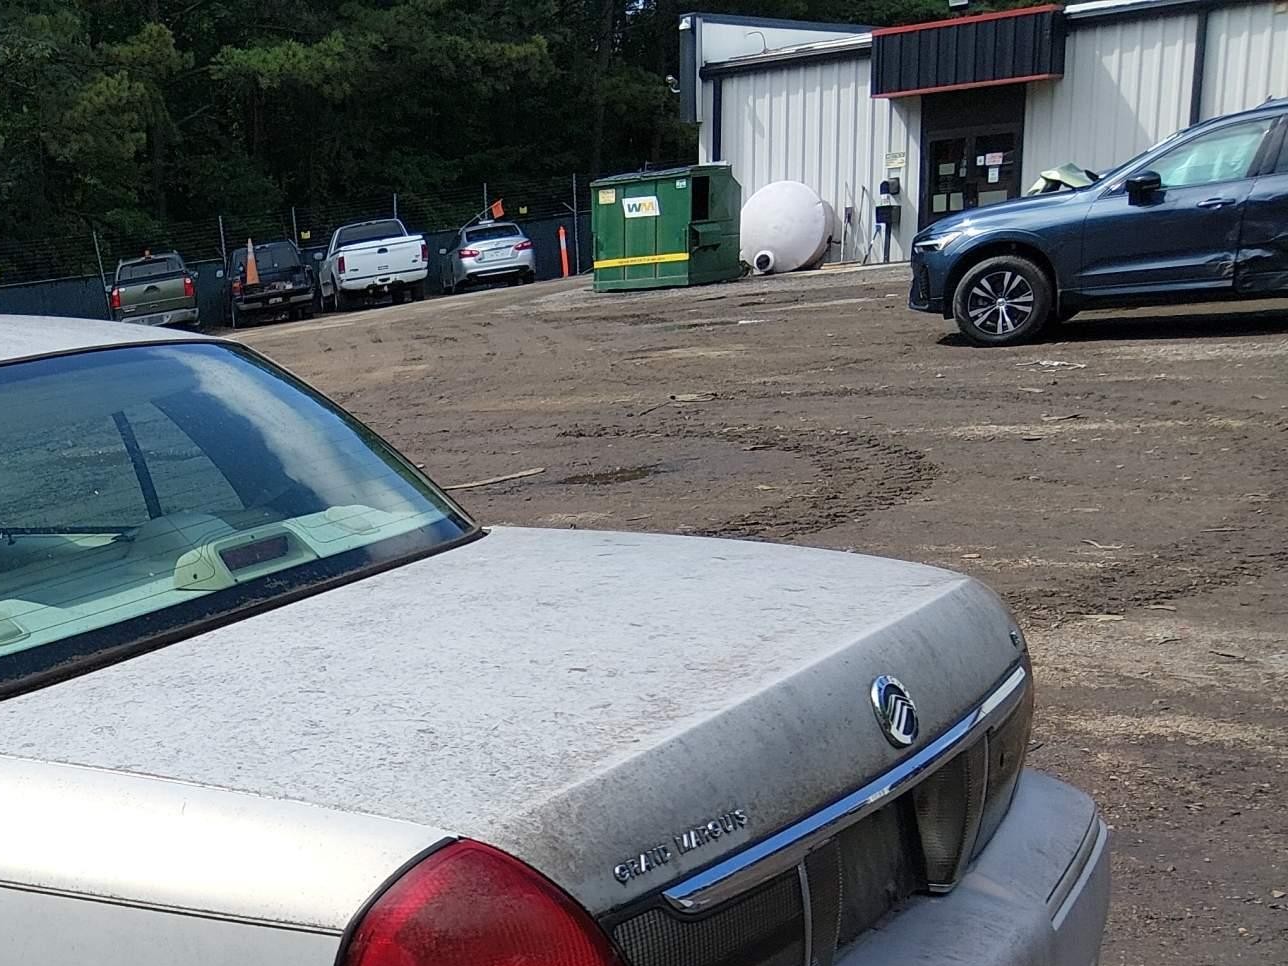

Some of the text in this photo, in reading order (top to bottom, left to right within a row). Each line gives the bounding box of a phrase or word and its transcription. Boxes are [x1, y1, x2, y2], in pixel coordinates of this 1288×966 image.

[626, 200, 655, 213] WM
[614, 809, 748, 884] GRAND MARQUIS
